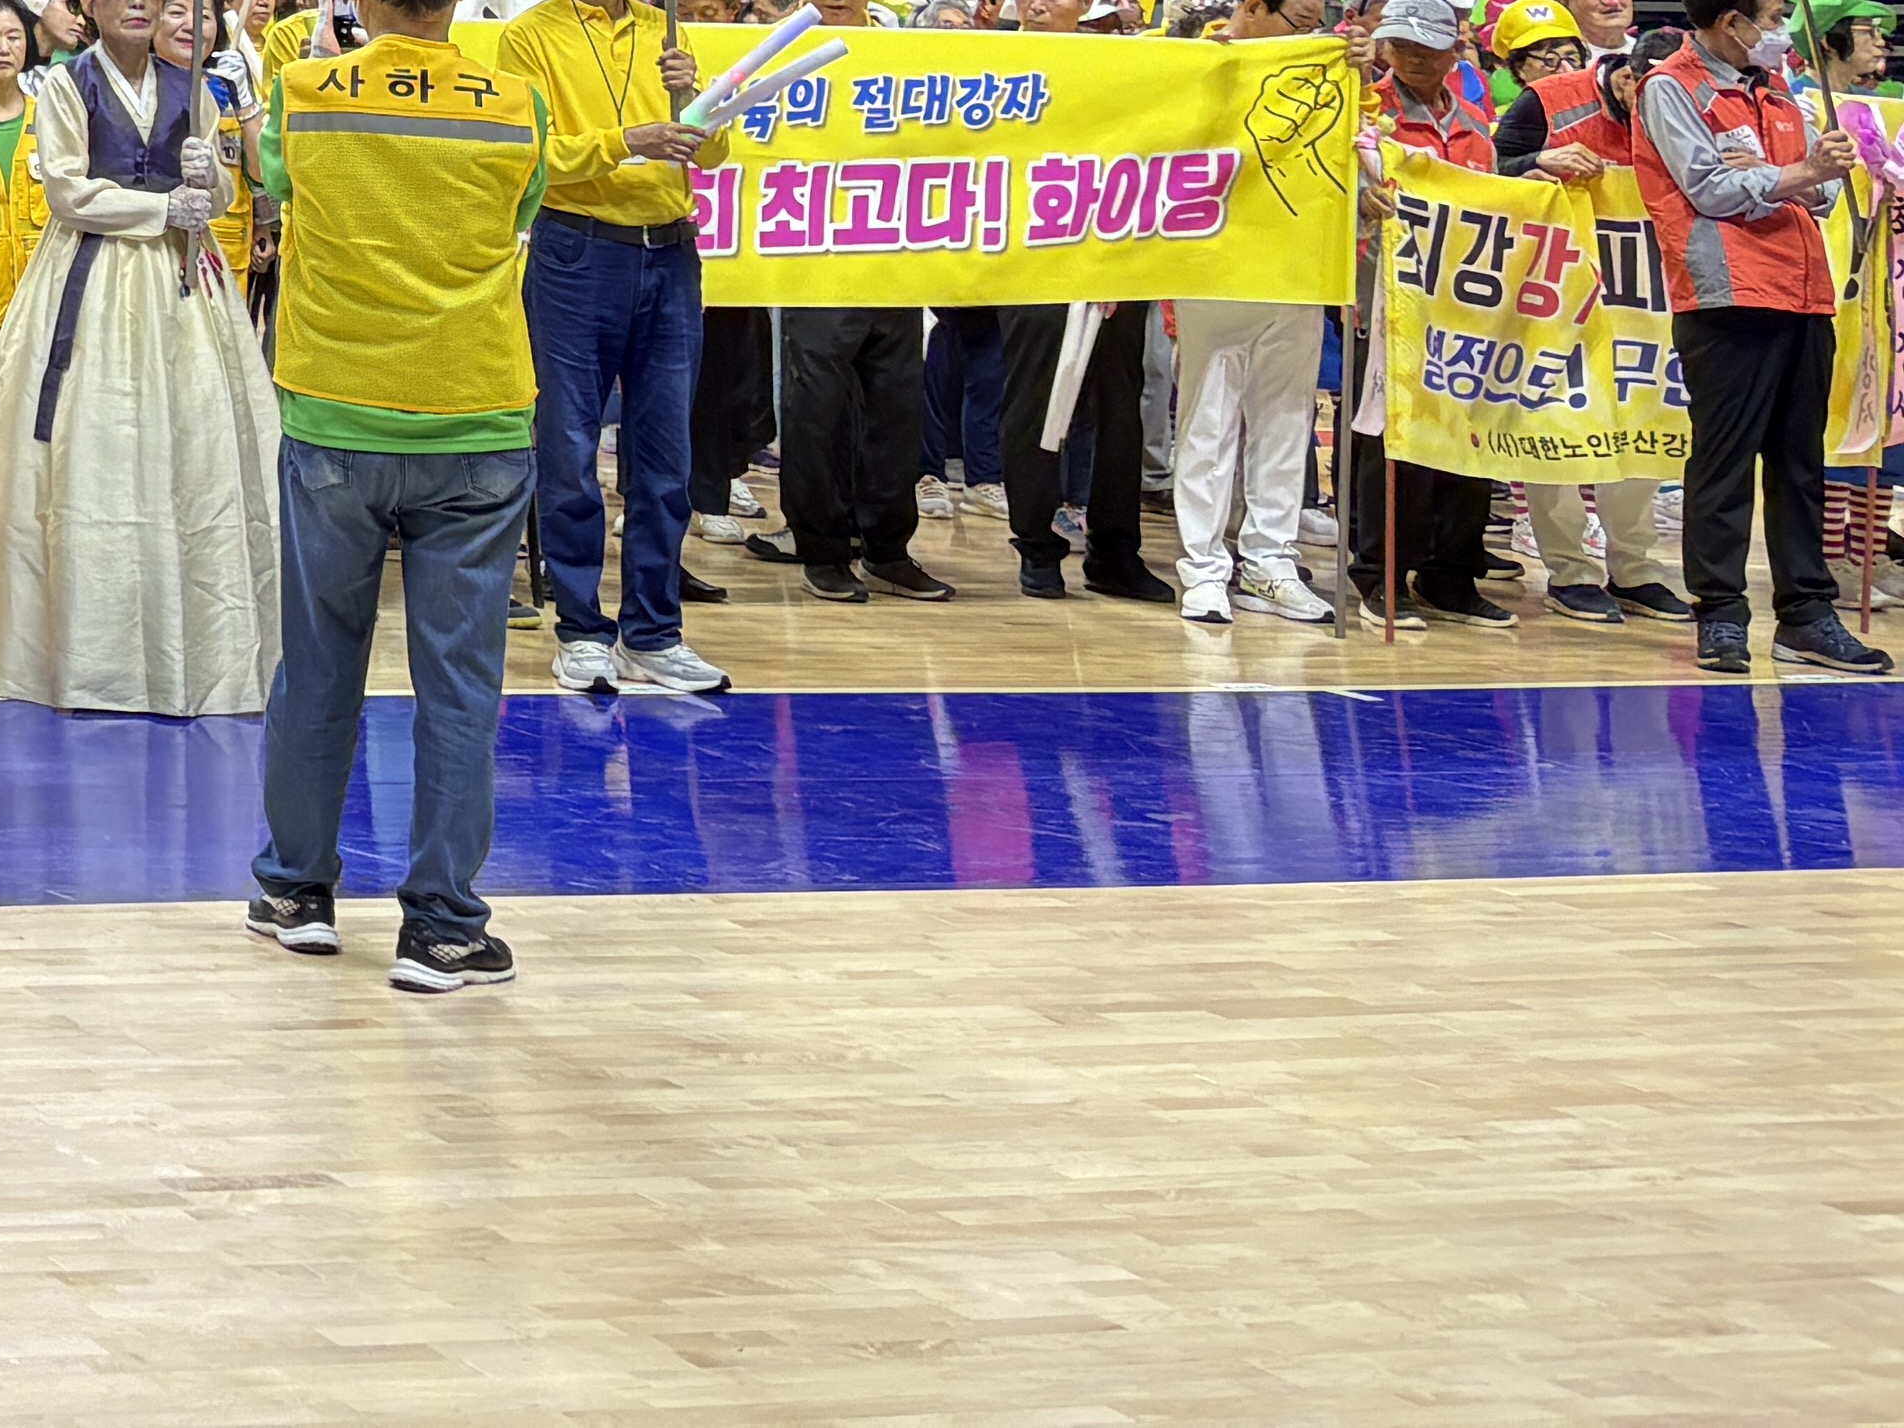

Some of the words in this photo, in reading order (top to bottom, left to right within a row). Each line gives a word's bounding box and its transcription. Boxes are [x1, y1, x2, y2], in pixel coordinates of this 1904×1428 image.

[316, 65, 500, 108] 사하구
[850, 70, 1052, 135] 절대강자
[759, 157, 1004, 256] 최고다!
[1026, 149, 1236, 247] 화이팅
